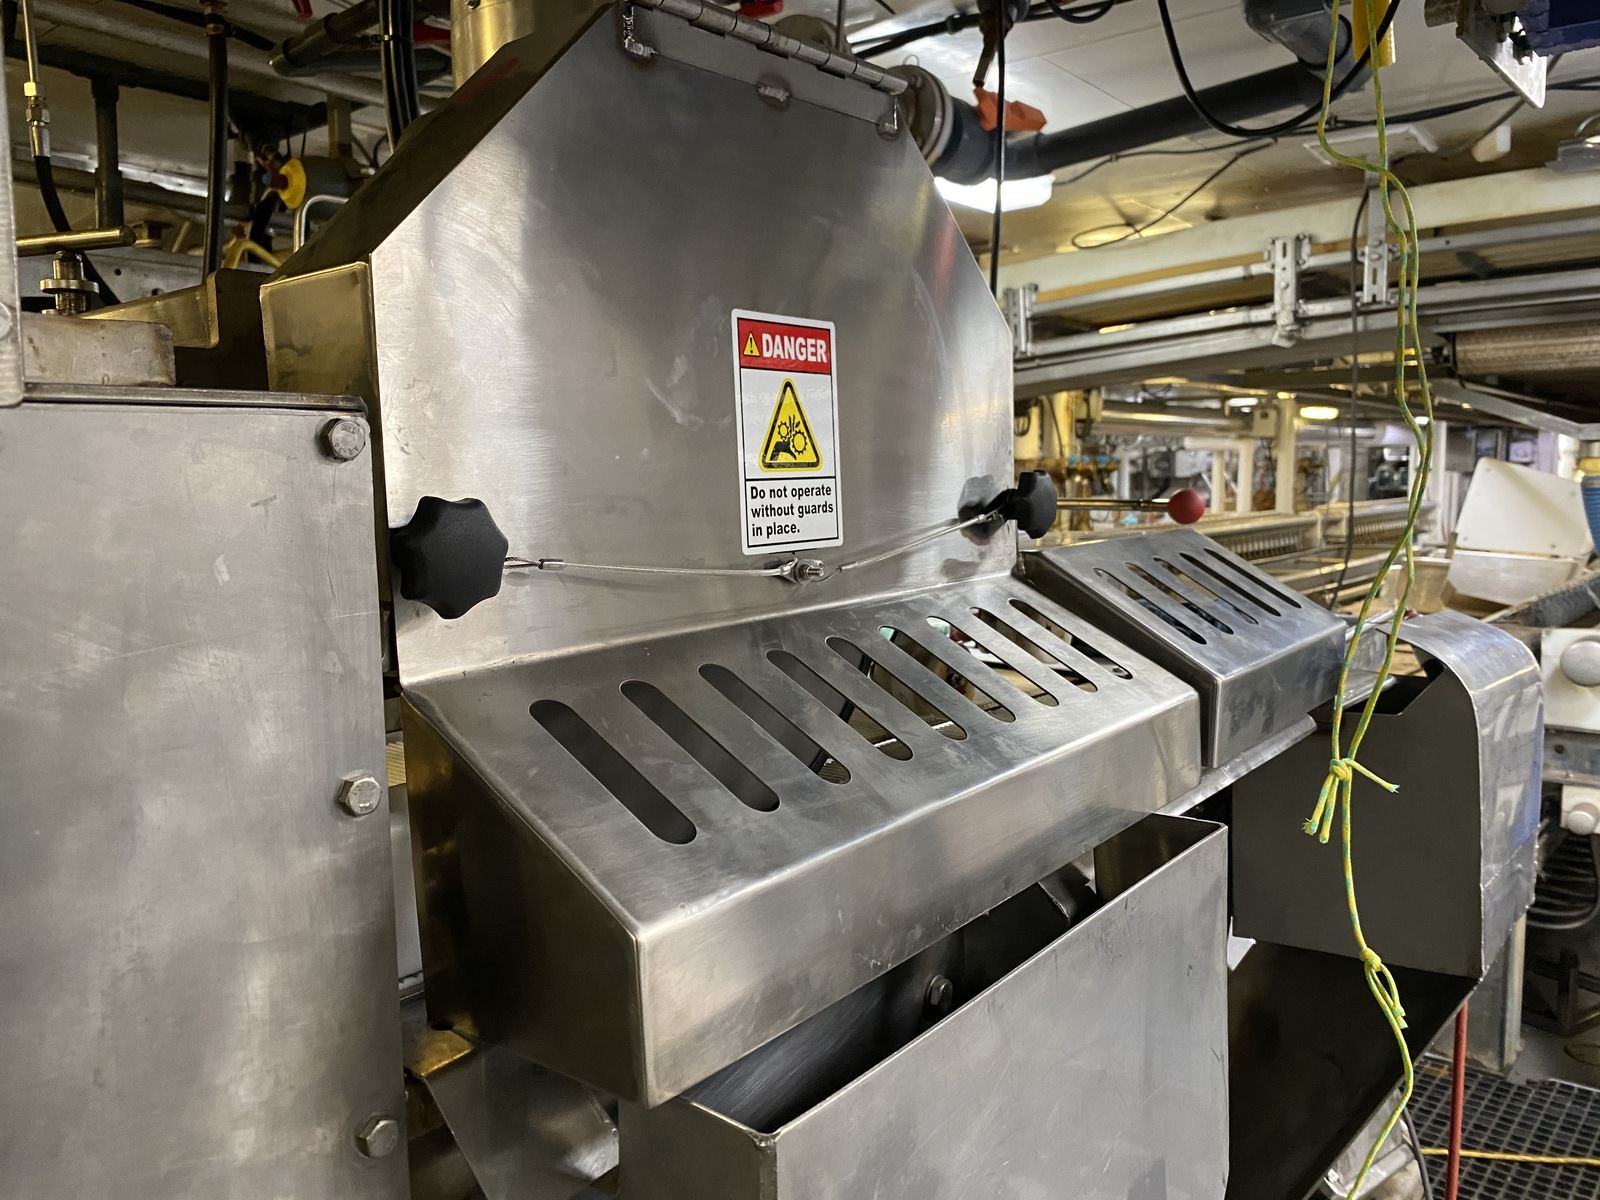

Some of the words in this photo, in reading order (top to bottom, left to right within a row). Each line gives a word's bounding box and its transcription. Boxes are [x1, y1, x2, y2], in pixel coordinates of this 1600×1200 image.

[762, 333, 827, 363] DANGER
[751, 486, 765, 499] Do
[769, 485, 787, 498] not
[791, 483, 831, 502] operate
[751, 503, 795, 517] without
[798, 501, 833, 520] guards
[752, 524, 762, 536] in
[766, 521, 800, 538] place.
